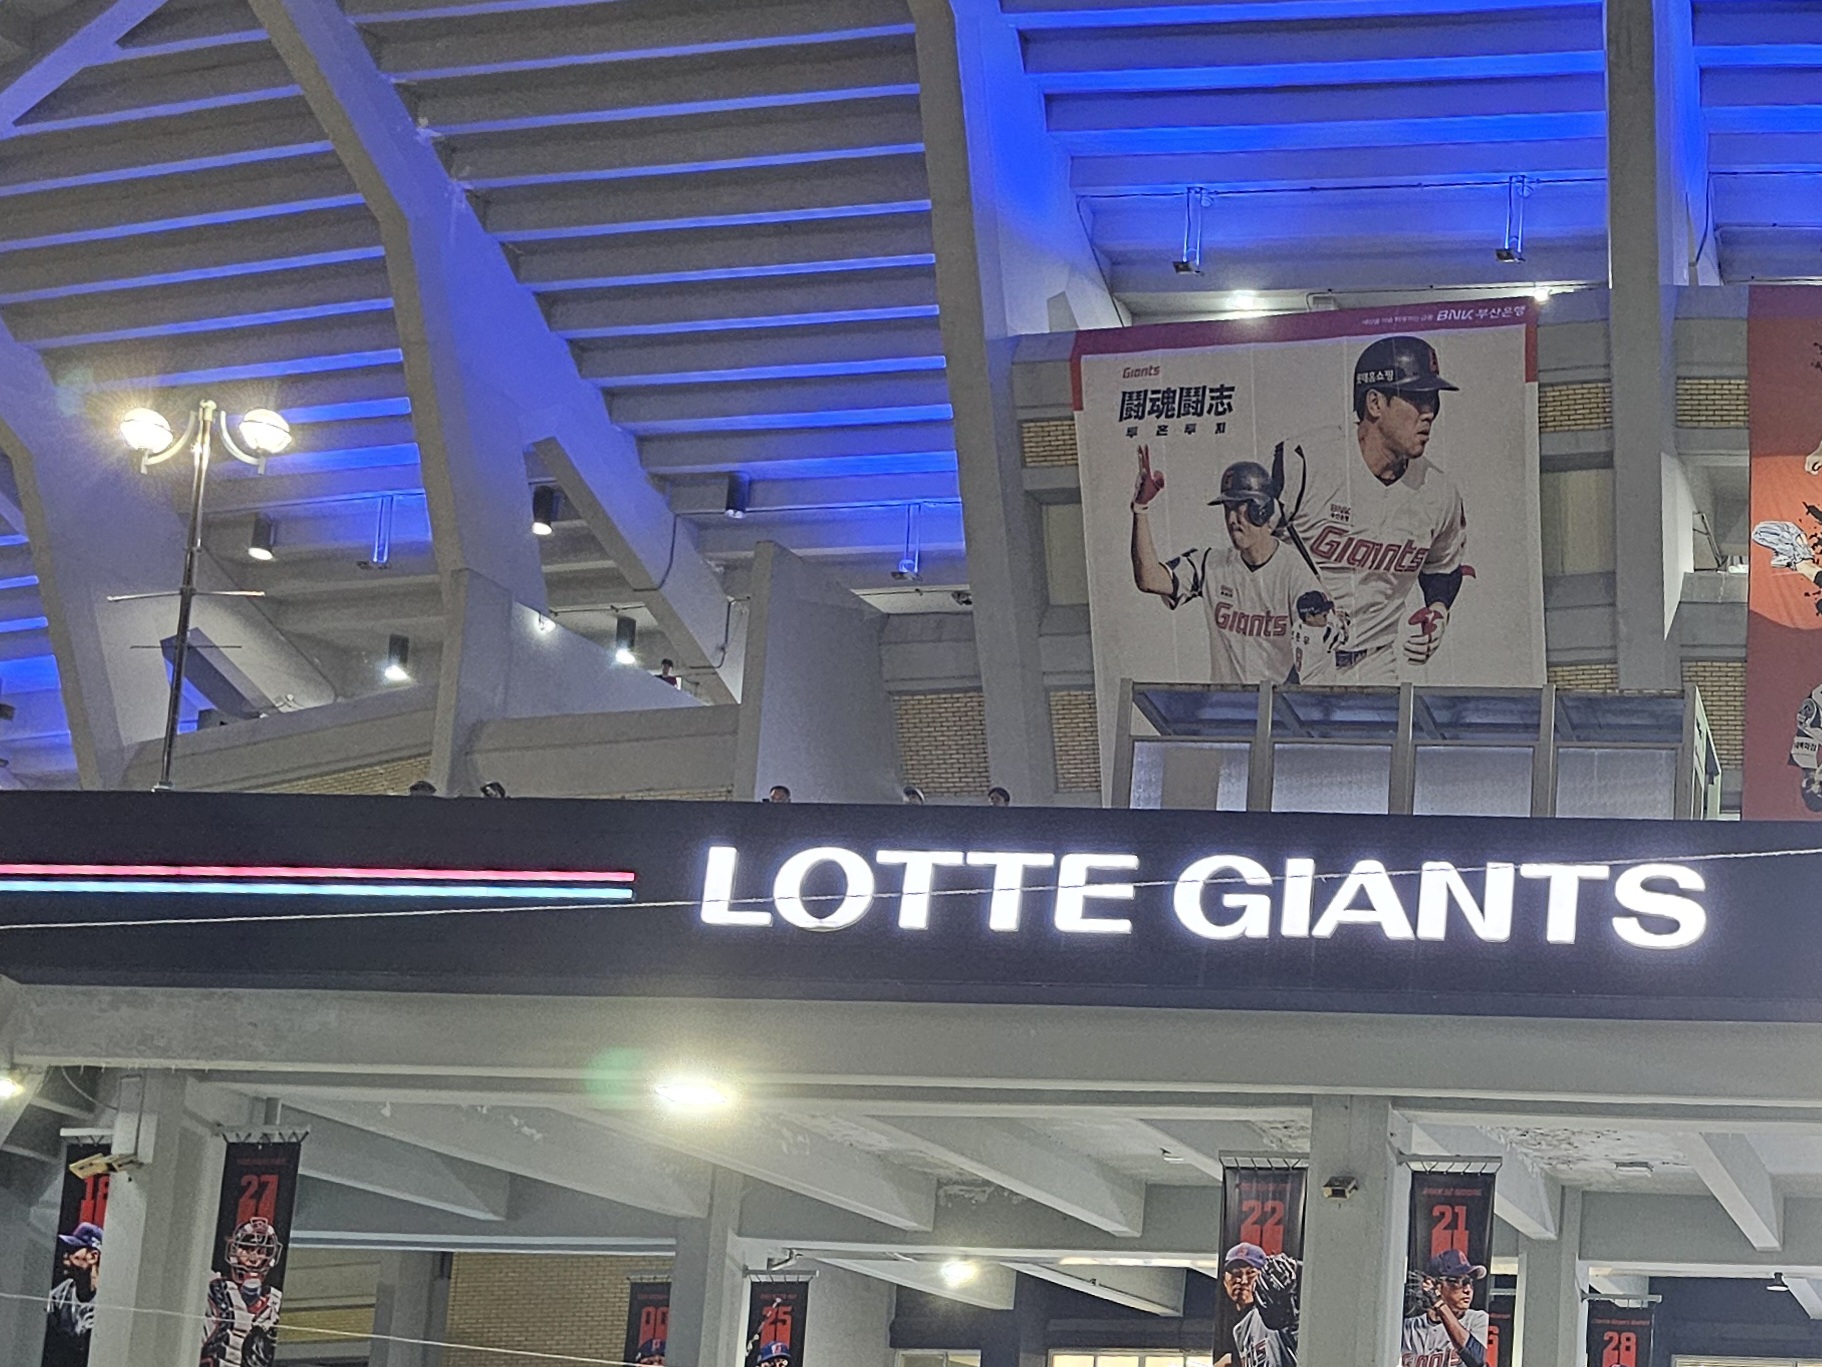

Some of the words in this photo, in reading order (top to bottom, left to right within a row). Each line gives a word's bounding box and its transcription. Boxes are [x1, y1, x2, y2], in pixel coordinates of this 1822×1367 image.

[1436, 310, 1474, 321] BNK
[1475, 305, 1527, 319] 부산은행
[1122, 365, 1161, 379] Giants
[1309, 525, 1429, 573] Giants
[1215, 601, 1290, 637] Giants
[702, 847, 1139, 938] LOTTE
[1174, 857, 1707, 951] GIANTS
[240, 1174, 279, 1201] 27
[1241, 1200, 1285, 1226] 22
[1431, 1204, 1468, 1231] 21
[762, 1305, 793, 1327] 25
[1603, 1331, 1637, 1352] 28
